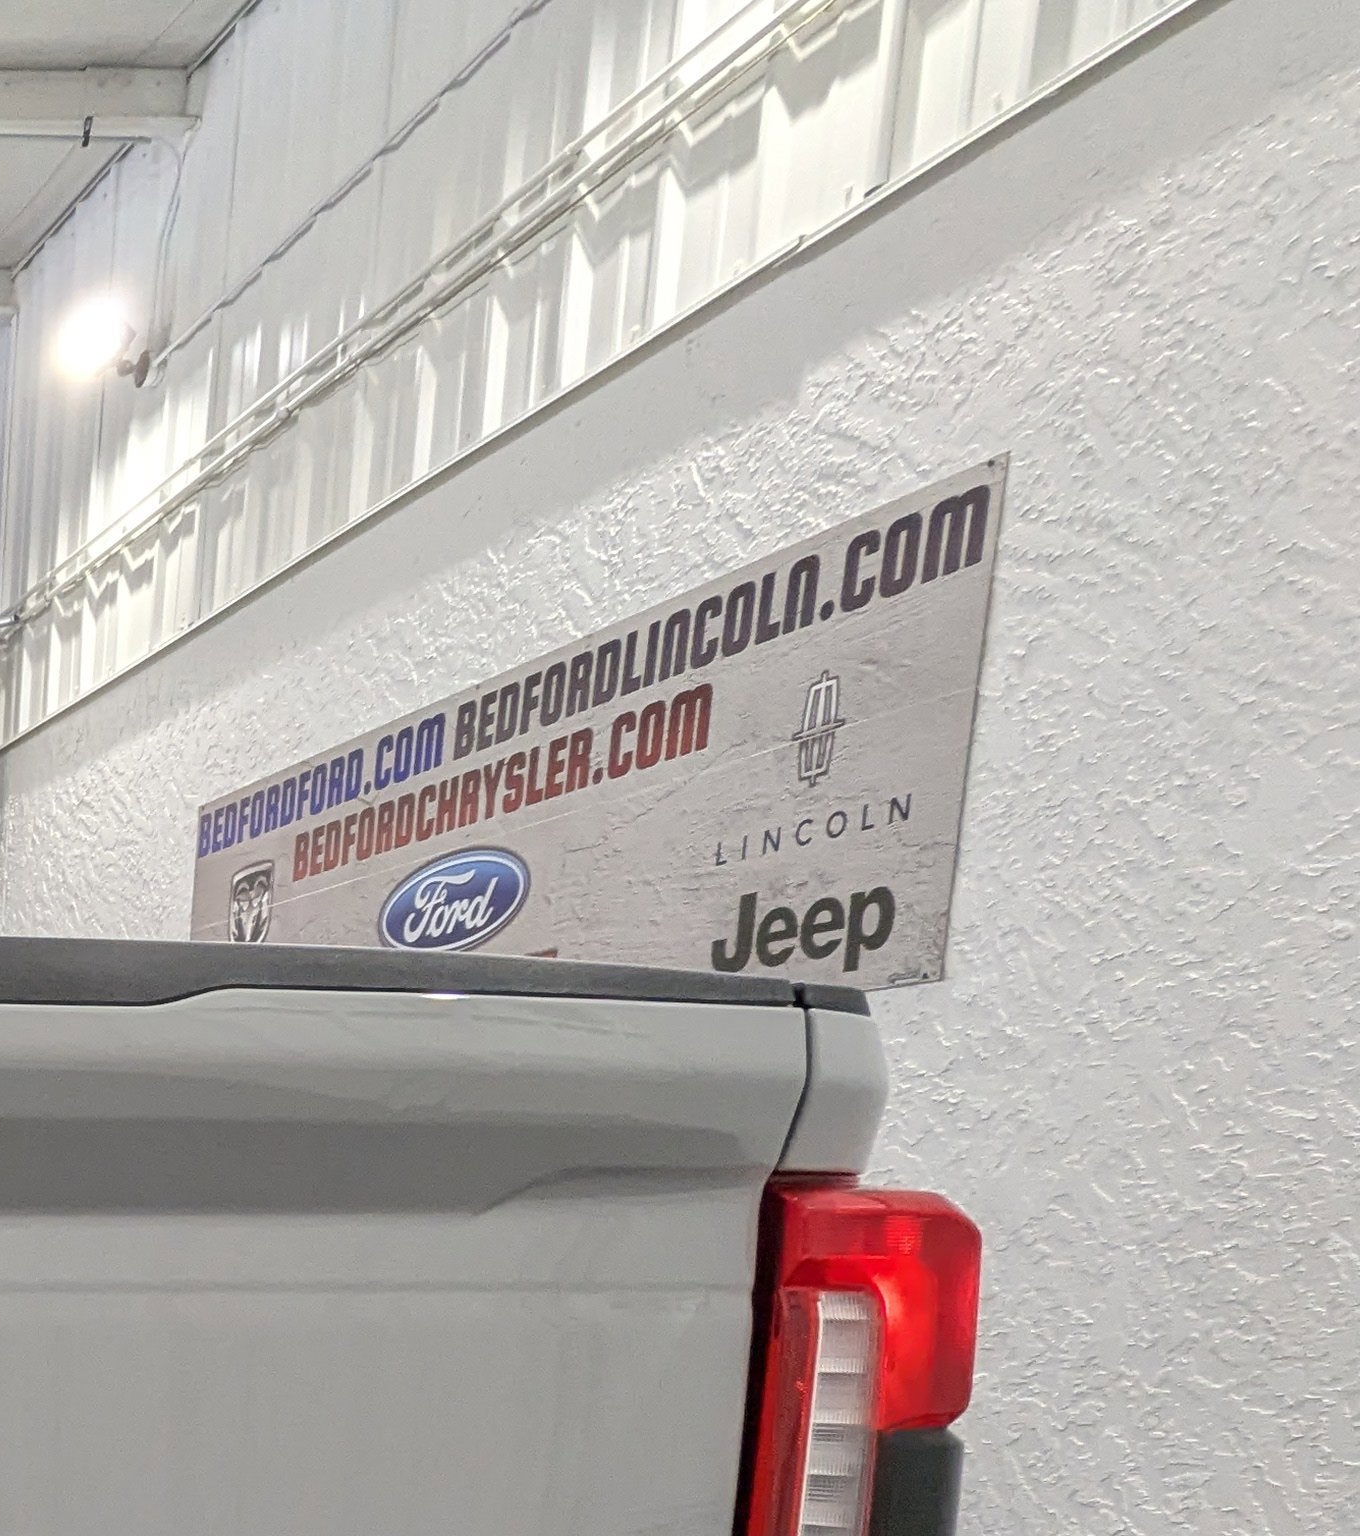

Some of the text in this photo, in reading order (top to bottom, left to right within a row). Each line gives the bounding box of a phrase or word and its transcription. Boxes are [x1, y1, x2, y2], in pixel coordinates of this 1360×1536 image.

[198, 484, 992, 858] BEDFORDFORD.COM BEDFORDLINCOLN.COM
[292, 683, 714, 882] BEDFORDCHRYSLER.COM
[714, 793, 912, 866] LINCOLN
[403, 868, 499, 944] Ford
[711, 886, 895, 973] Jeep
